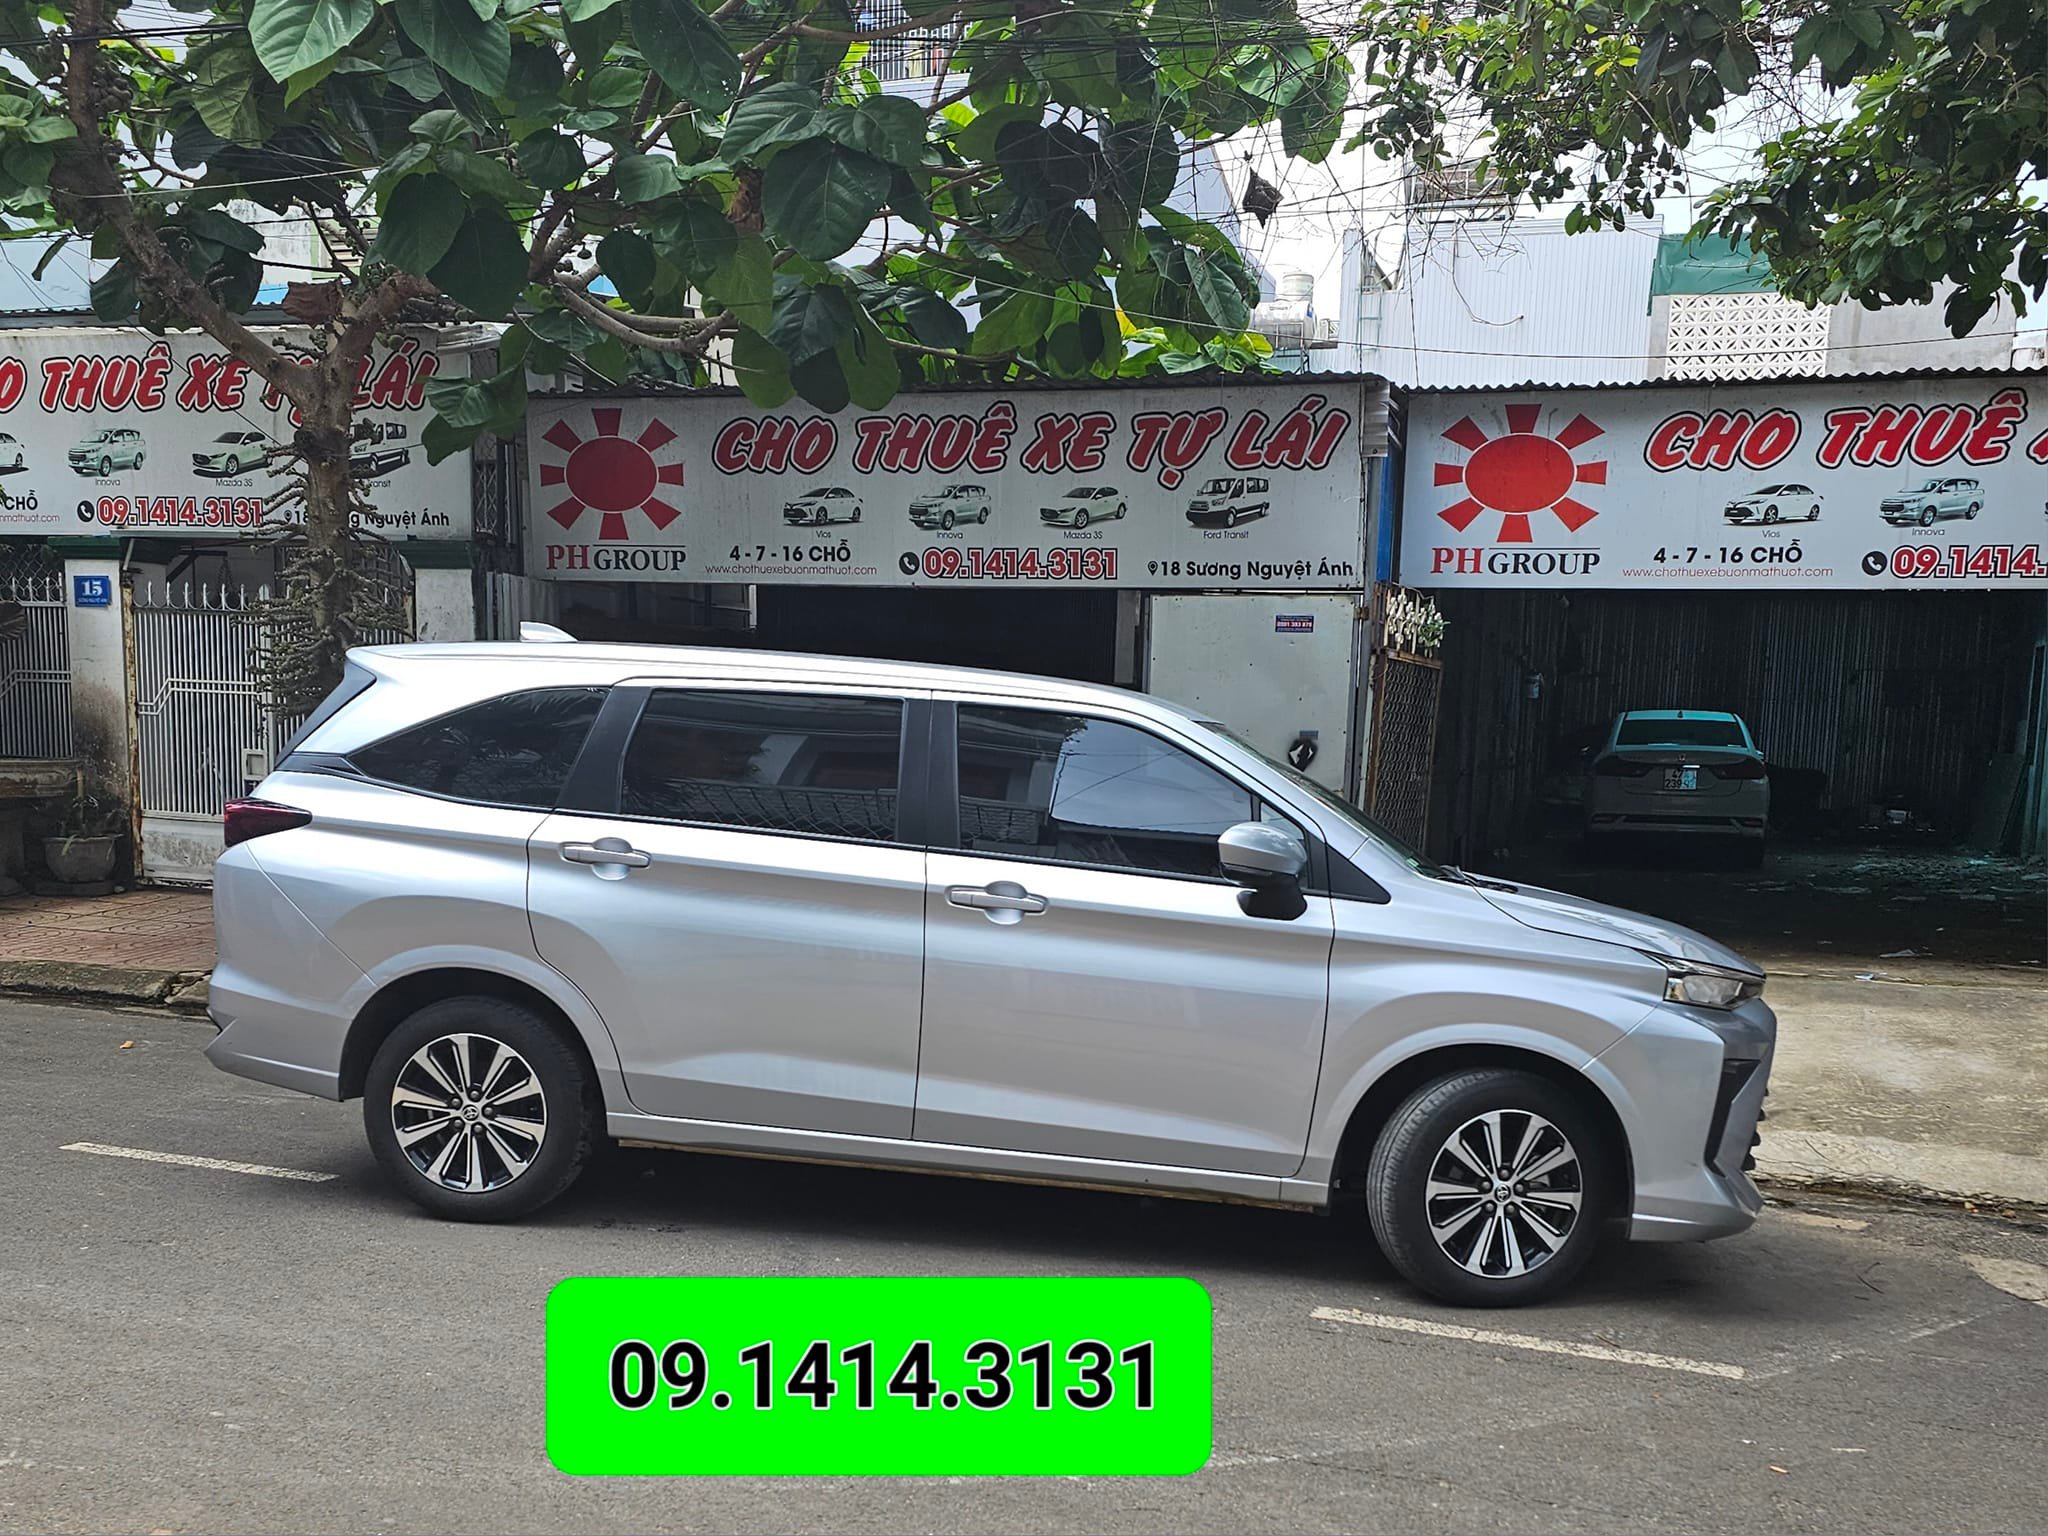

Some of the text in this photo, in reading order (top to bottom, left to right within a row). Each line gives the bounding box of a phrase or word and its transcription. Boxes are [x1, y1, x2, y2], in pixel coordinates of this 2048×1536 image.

[40, 341, 172, 412] THUÊ
[176, 354, 251, 412] XE
[1643, 407, 1802, 473] CHO
[1816, 387, 2029, 470] THUÊ
[712, 393, 1352, 491] CHO THUÊ XE TỰ LÁI
[95, 478, 121, 486] Innova
[216, 478, 241, 487] Mazda
[368, 479, 391, 488] ransit
[4, 489, 38, 510] CHỖ
[97, 496, 263, 527] 09.1414.3131
[365, 511, 417, 529] Nguyệt
[421, 508, 450, 525] Ánh
[815, 529, 832, 538] Vios
[937, 531, 964, 540] Innova
[1063, 531, 1104, 540] Mazda 3S
[1203, 530, 1249, 539] Ford Transit
[1762, 529, 1781, 539] Vios
[1912, 527, 1945, 536] Innova
[729, 546, 740, 561] 4
[755, 546, 765, 561] 7
[783, 546, 803, 561] 16
[808, 539, 851, 562] CHỖ
[1653, 547, 1667, 563] 4
[1686, 547, 1698, 563] 7
[1719, 547, 1744, 563] 16
[1750, 539, 1802, 563] CHỖ
[705, 563, 877, 576] www.chothuexebuonmathuot.com
[922, 547, 1119, 580] 09.1414.3131
[1161, 557, 1353, 580] 18 Sương Nguyệt Ánh
[1622, 566, 1833, 578] www.chothuexebuonmathuot.com
[81, 579, 103, 596] 15
